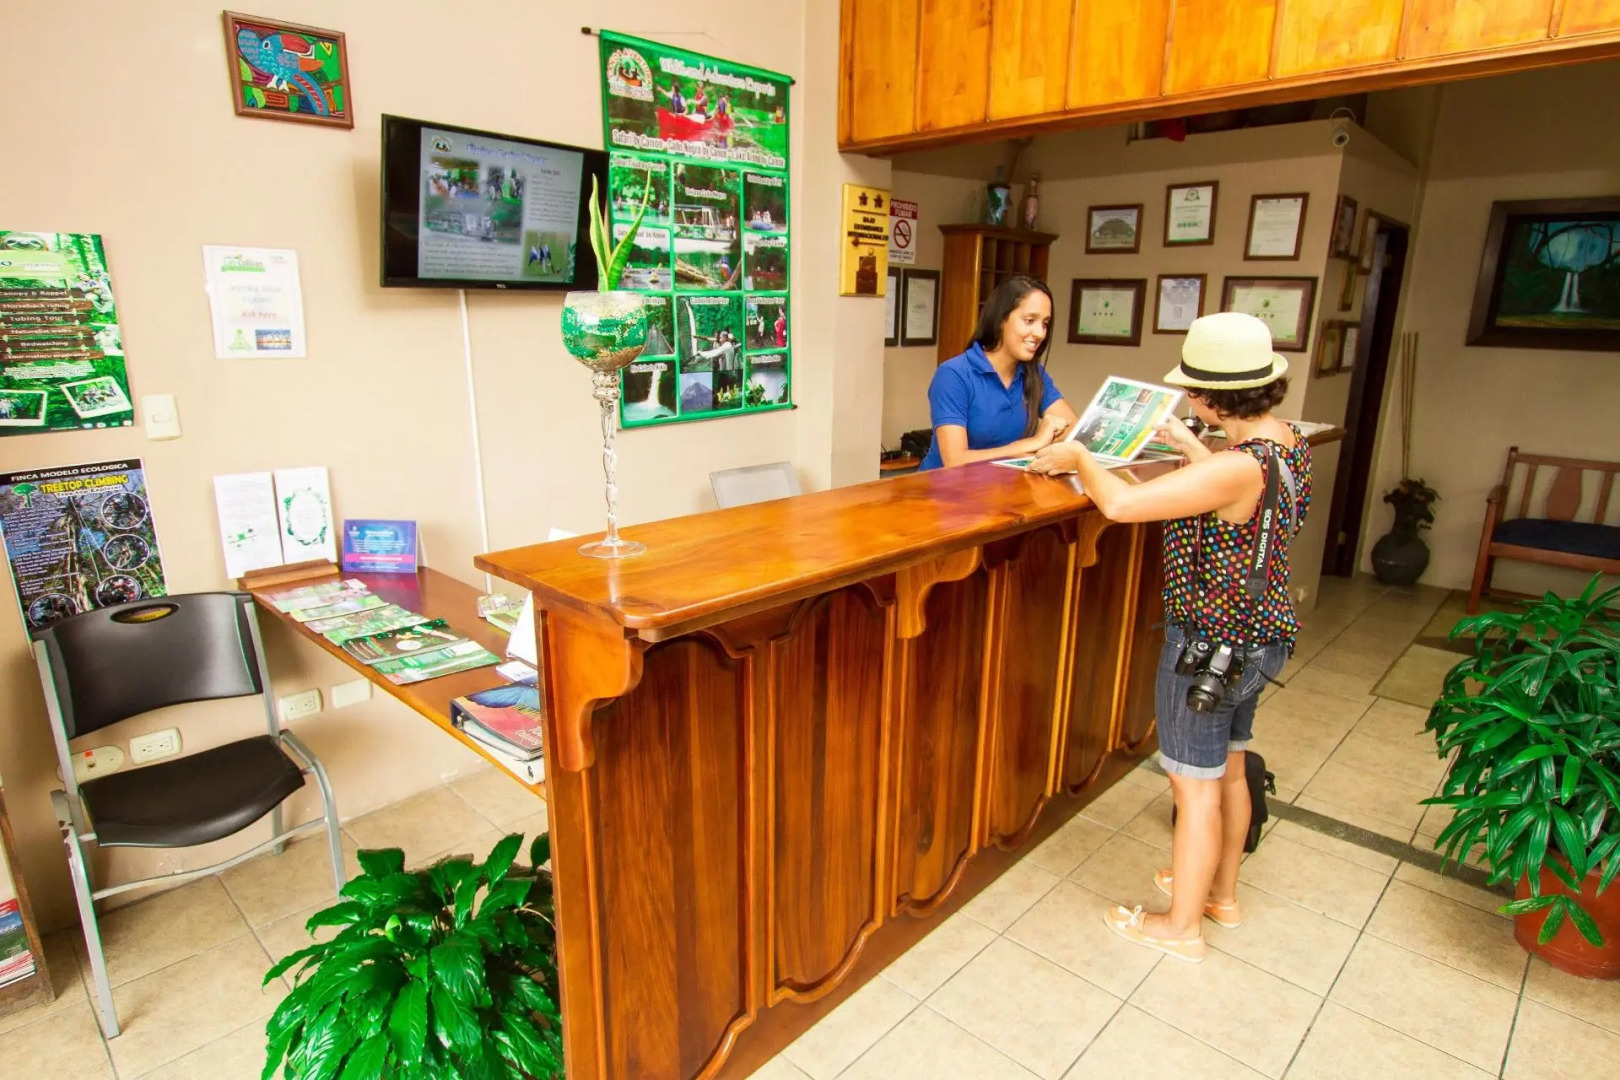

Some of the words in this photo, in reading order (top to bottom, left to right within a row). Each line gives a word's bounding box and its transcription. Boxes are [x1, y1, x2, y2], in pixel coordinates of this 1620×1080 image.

[640, 134, 664, 150] Canoe
[241, 310, 257, 318] Ask
[11, 473, 39, 482] FINCA
[40, 468, 79, 479] MODELO
[81, 462, 129, 474] ECOLOGICA
[40, 480, 83, 494] TREETOP
[85, 474, 129, 488] CLIMBING
[1262, 509, 1272, 529] EOS
[1255, 532, 1268, 571] DIGITAL
